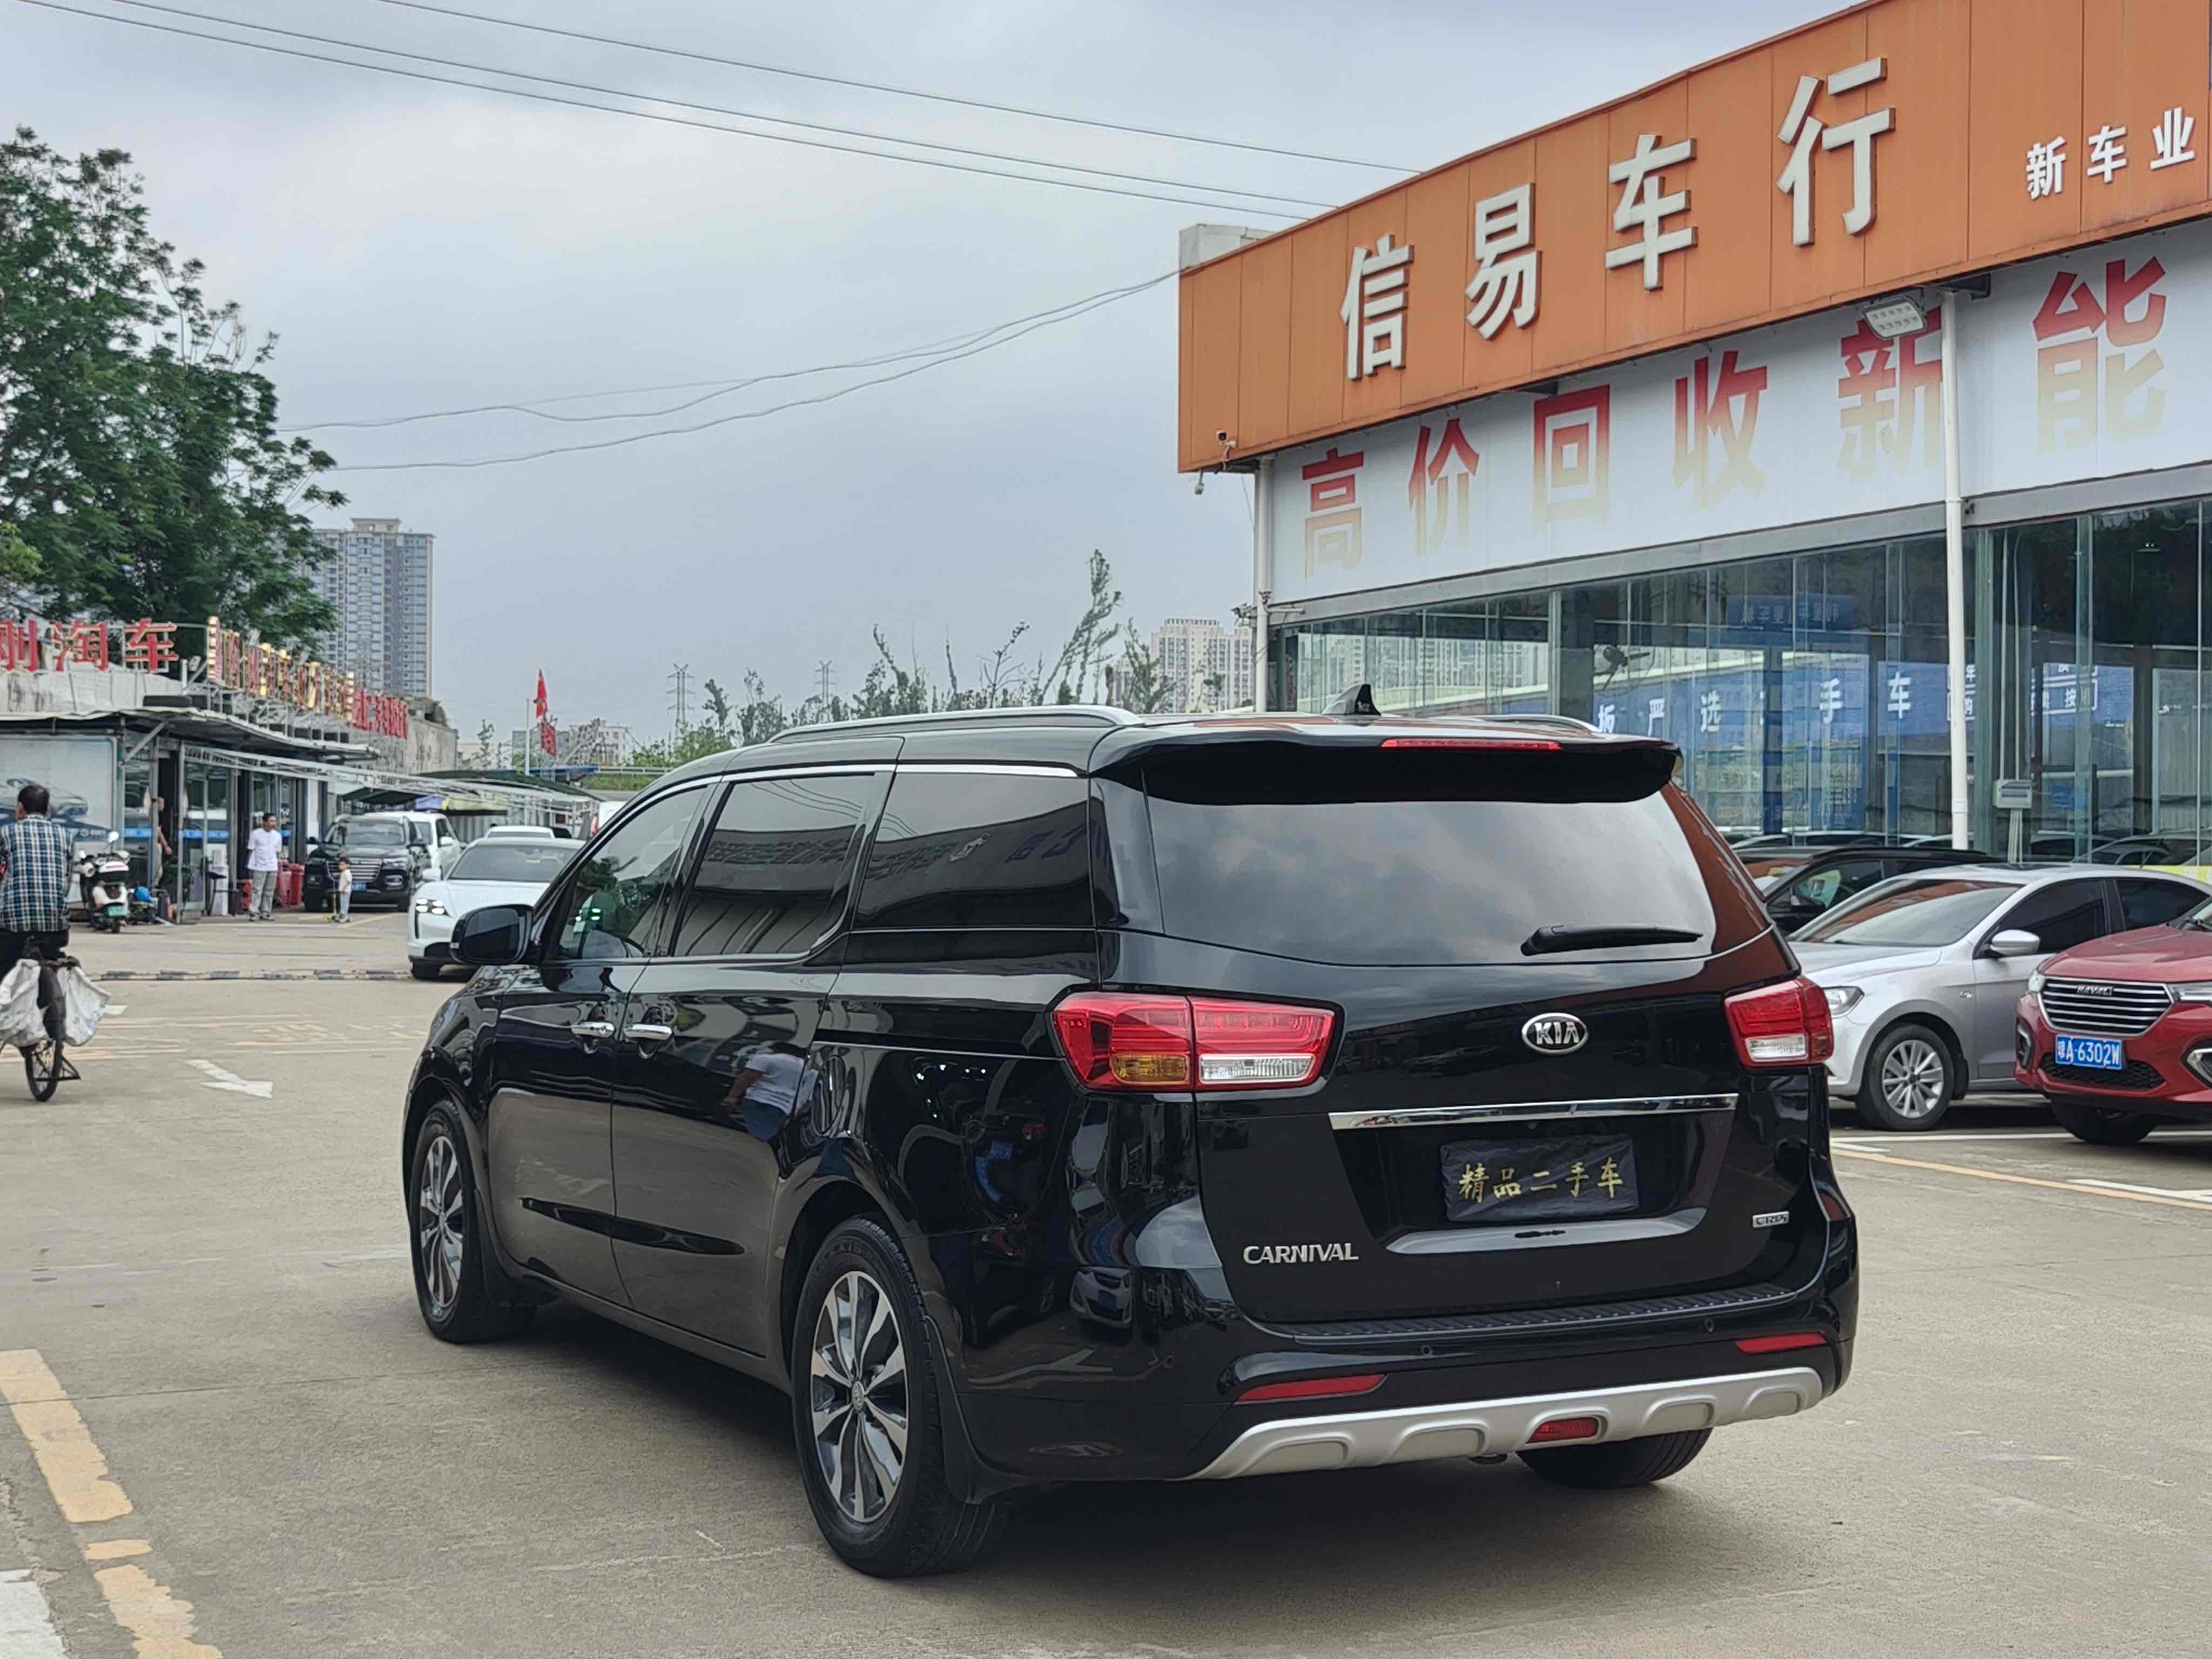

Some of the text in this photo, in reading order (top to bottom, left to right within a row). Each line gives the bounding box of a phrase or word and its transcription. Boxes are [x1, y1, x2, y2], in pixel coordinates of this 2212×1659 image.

[2026, 107, 2195, 200] 新车业
[1340, 56, 1896, 382] 信易车行
[2075, 985, 2114, 996] HAVAL
[1534, 1021, 1580, 1044] KIA
[1459, 1156, 1623, 1204] 精品二手车
[1243, 1242, 1359, 1264] CARNIVAL
